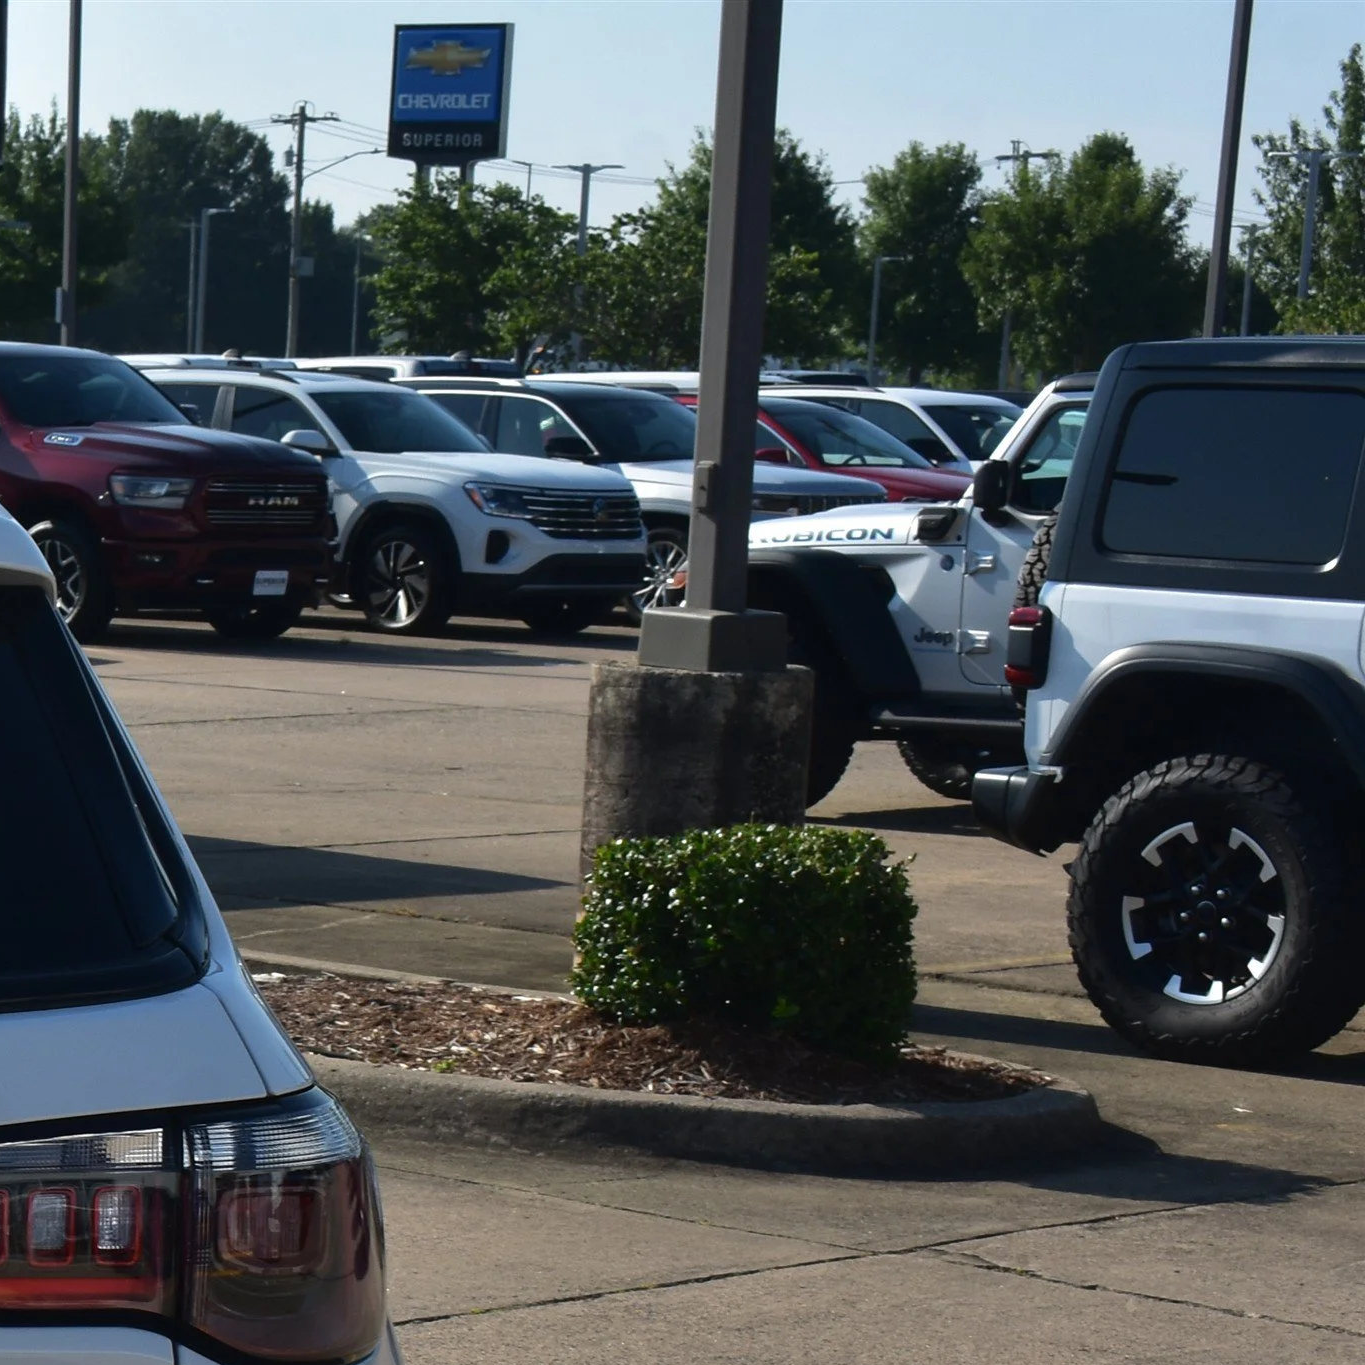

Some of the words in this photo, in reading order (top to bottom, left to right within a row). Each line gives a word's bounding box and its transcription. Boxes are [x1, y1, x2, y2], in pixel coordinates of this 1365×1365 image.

[397, 93, 491, 110] CHEVROLET
[402, 132, 483, 148] SUPERIOR
[749, 528, 895, 544] UBICON
[913, 627, 954, 647] Jeep
